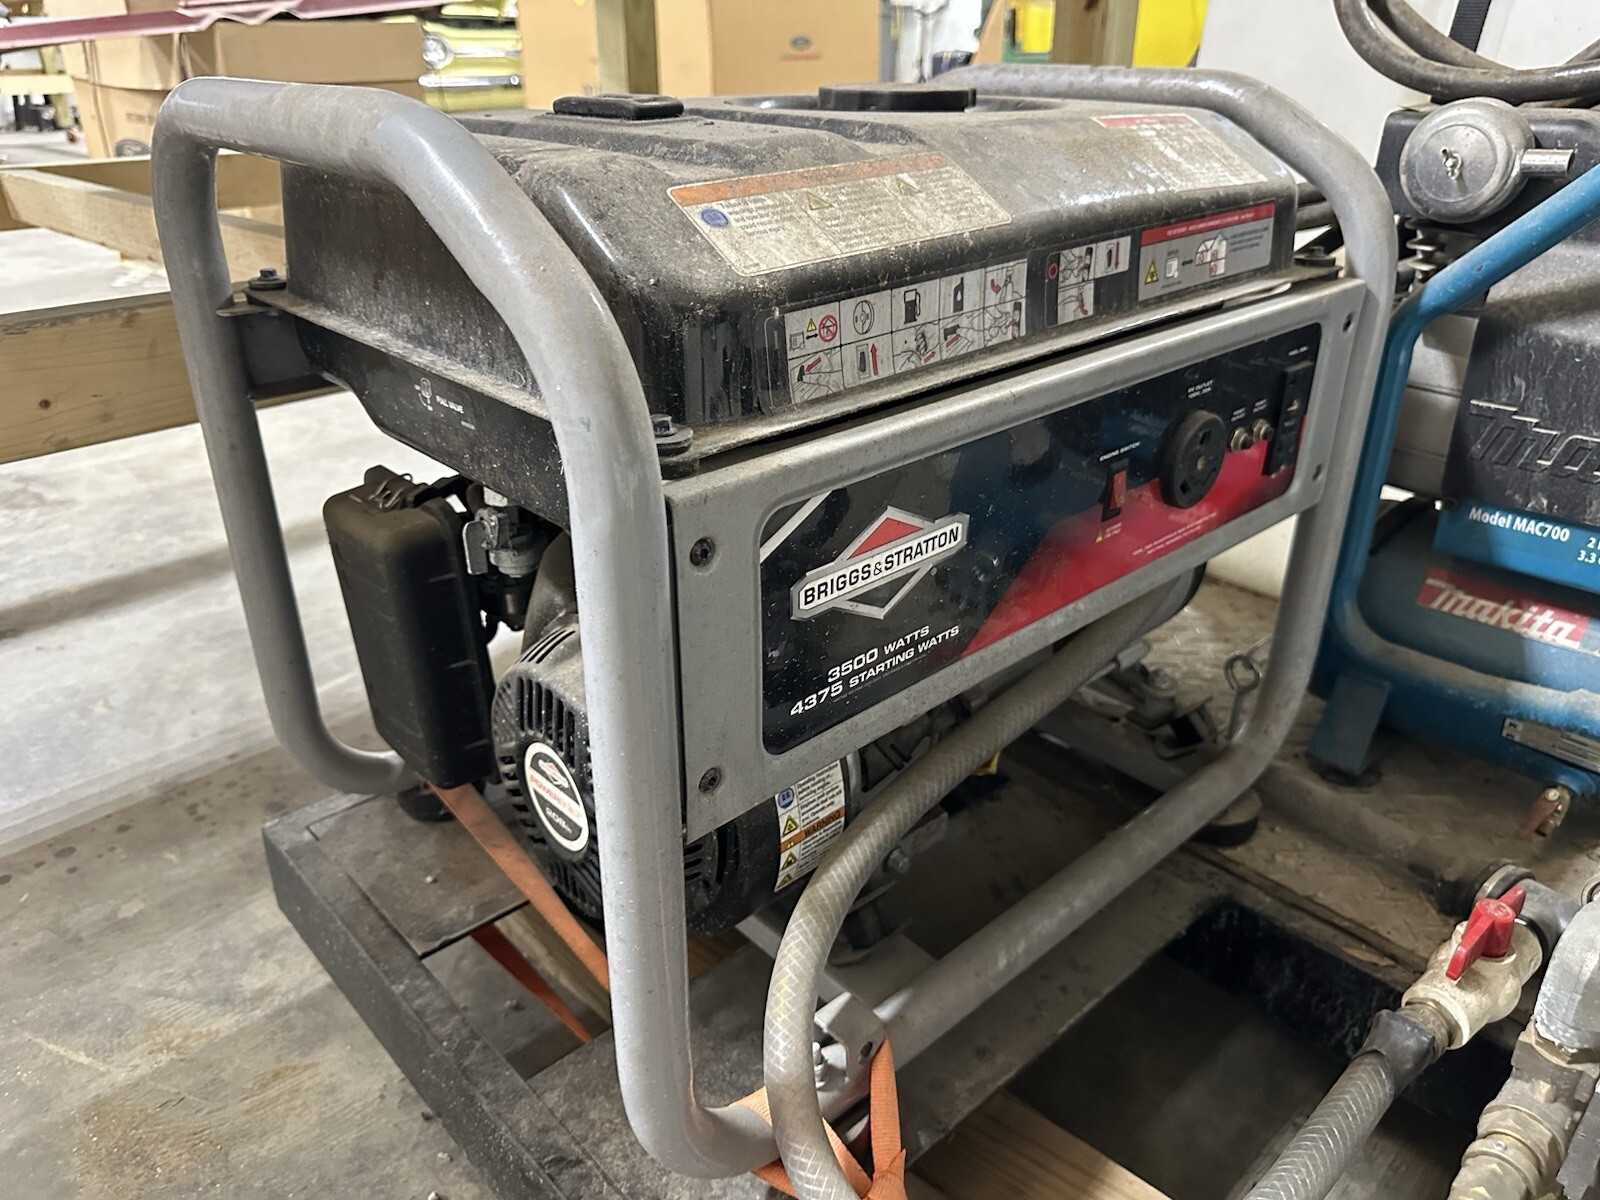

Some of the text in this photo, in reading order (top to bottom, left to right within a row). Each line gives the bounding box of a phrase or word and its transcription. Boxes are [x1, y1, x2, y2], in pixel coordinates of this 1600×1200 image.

[1469, 507, 1570, 542] Model MAC700
[1577, 550, 1597, 564] 3.3
[1587, 537, 1597, 549] 2
[803, 526, 960, 606] BRIGGS&STRATTON
[790, 682, 843, 716] 4375
[848, 649, 914, 688] STARTING
[917, 626, 960, 653] WATTS
[827, 648, 878, 682] 3500
[883, 625, 930, 655] WATTS
[804, 809, 841, 838] WARNING
